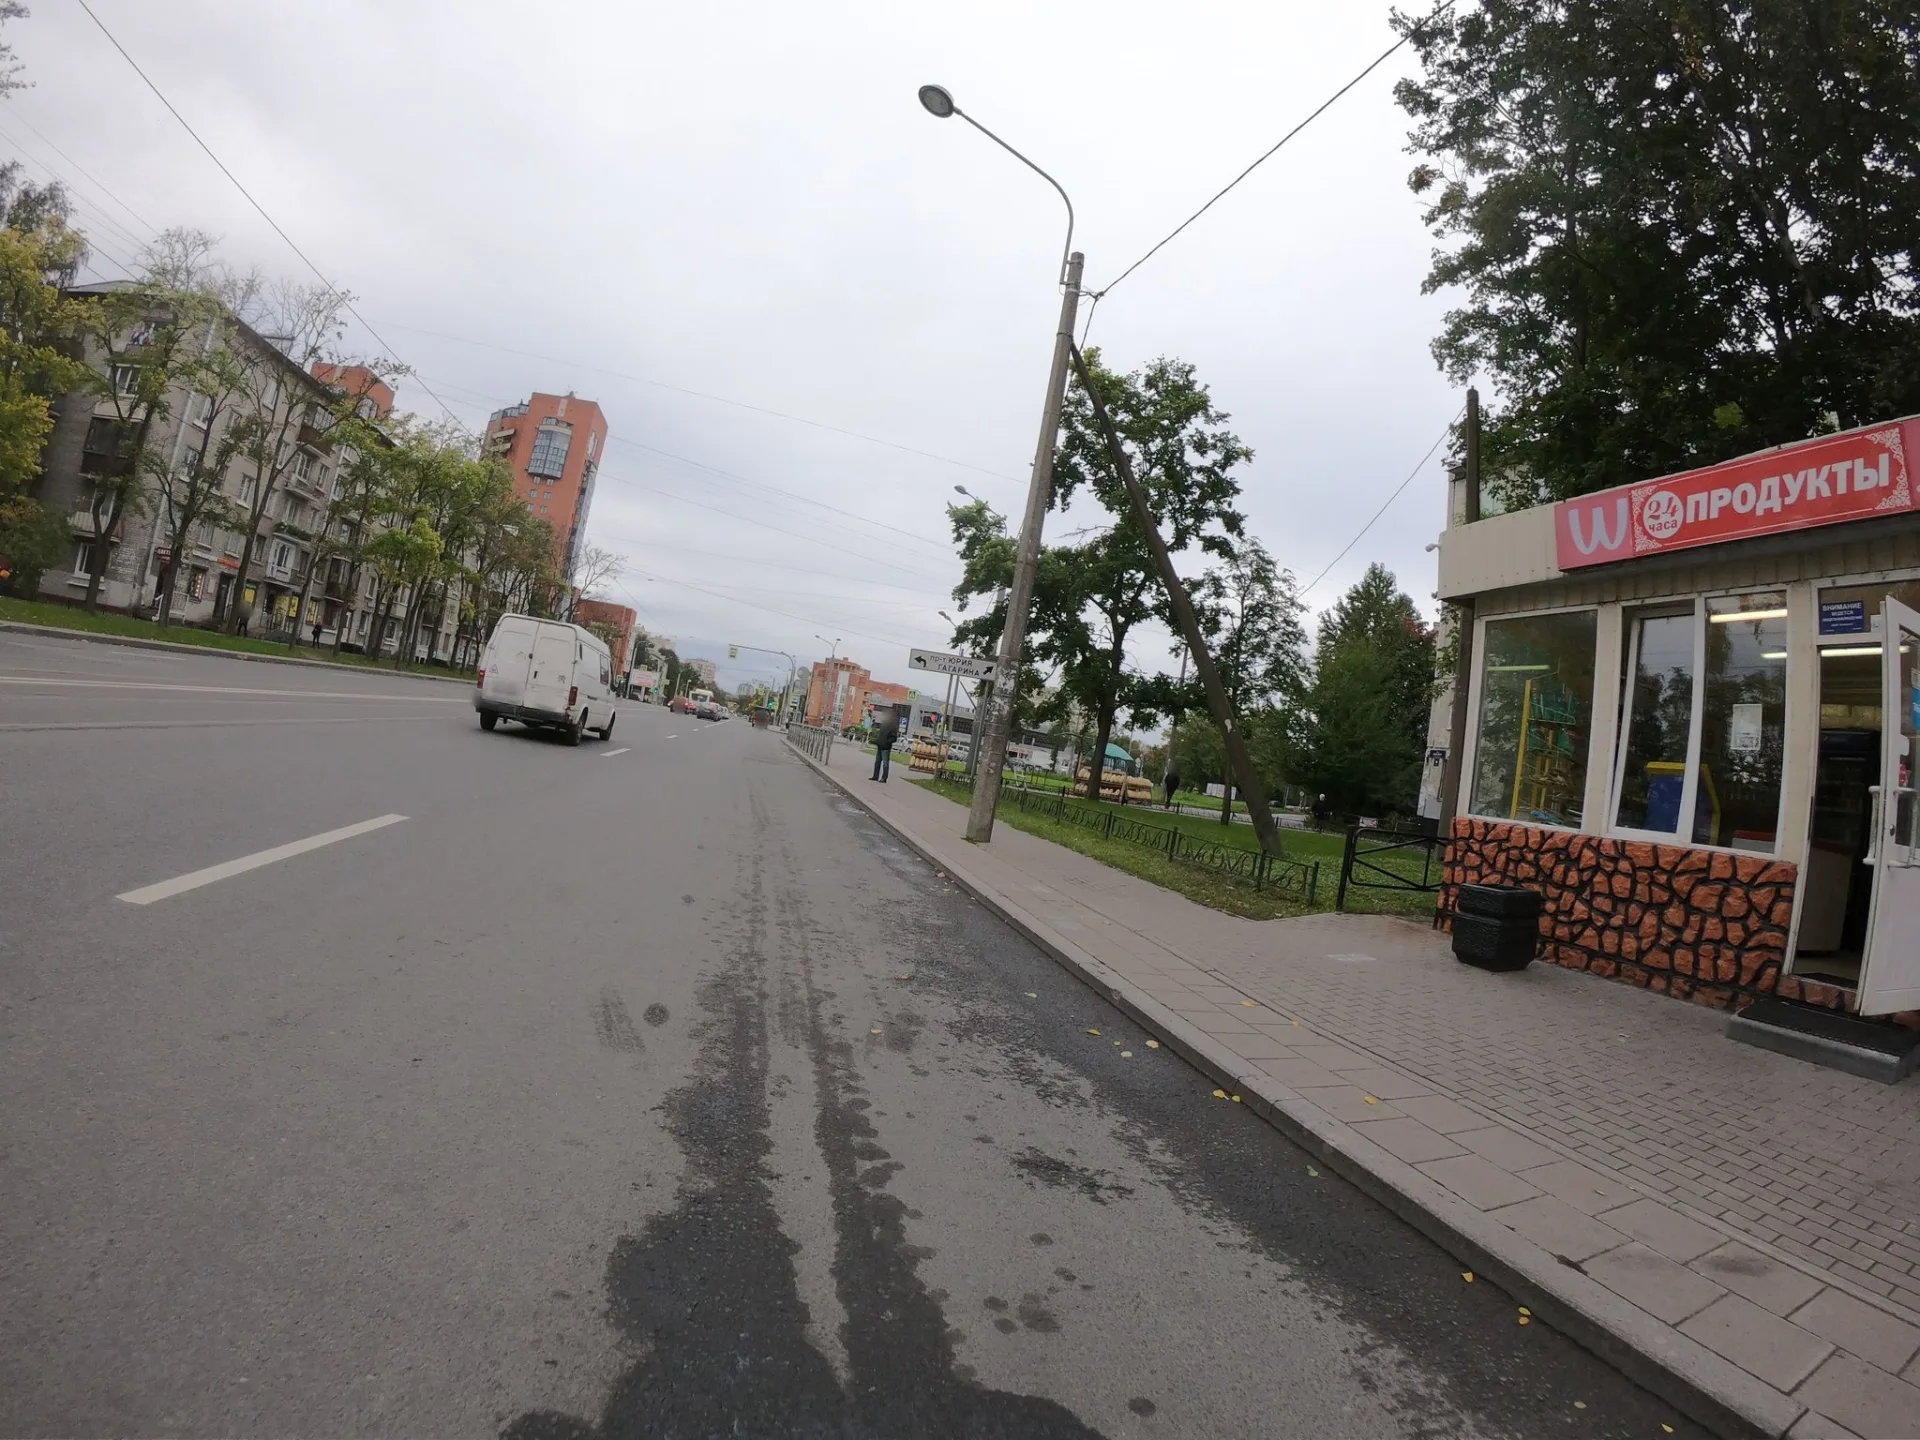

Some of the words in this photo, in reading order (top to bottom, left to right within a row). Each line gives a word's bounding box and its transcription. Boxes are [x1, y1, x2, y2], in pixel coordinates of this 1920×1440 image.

[1685, 453, 1889, 523] ПРОДУКТЫ
[1648, 496, 1679, 520] 24
[1648, 519, 1678, 532] часа
[1822, 602, 1862, 612] ВНИМАНИЕ
[930, 655, 947, 663] пр-т
[947, 656, 973, 667] ЮРИЯ
[937, 664, 980, 676] ГАГАРИНА
